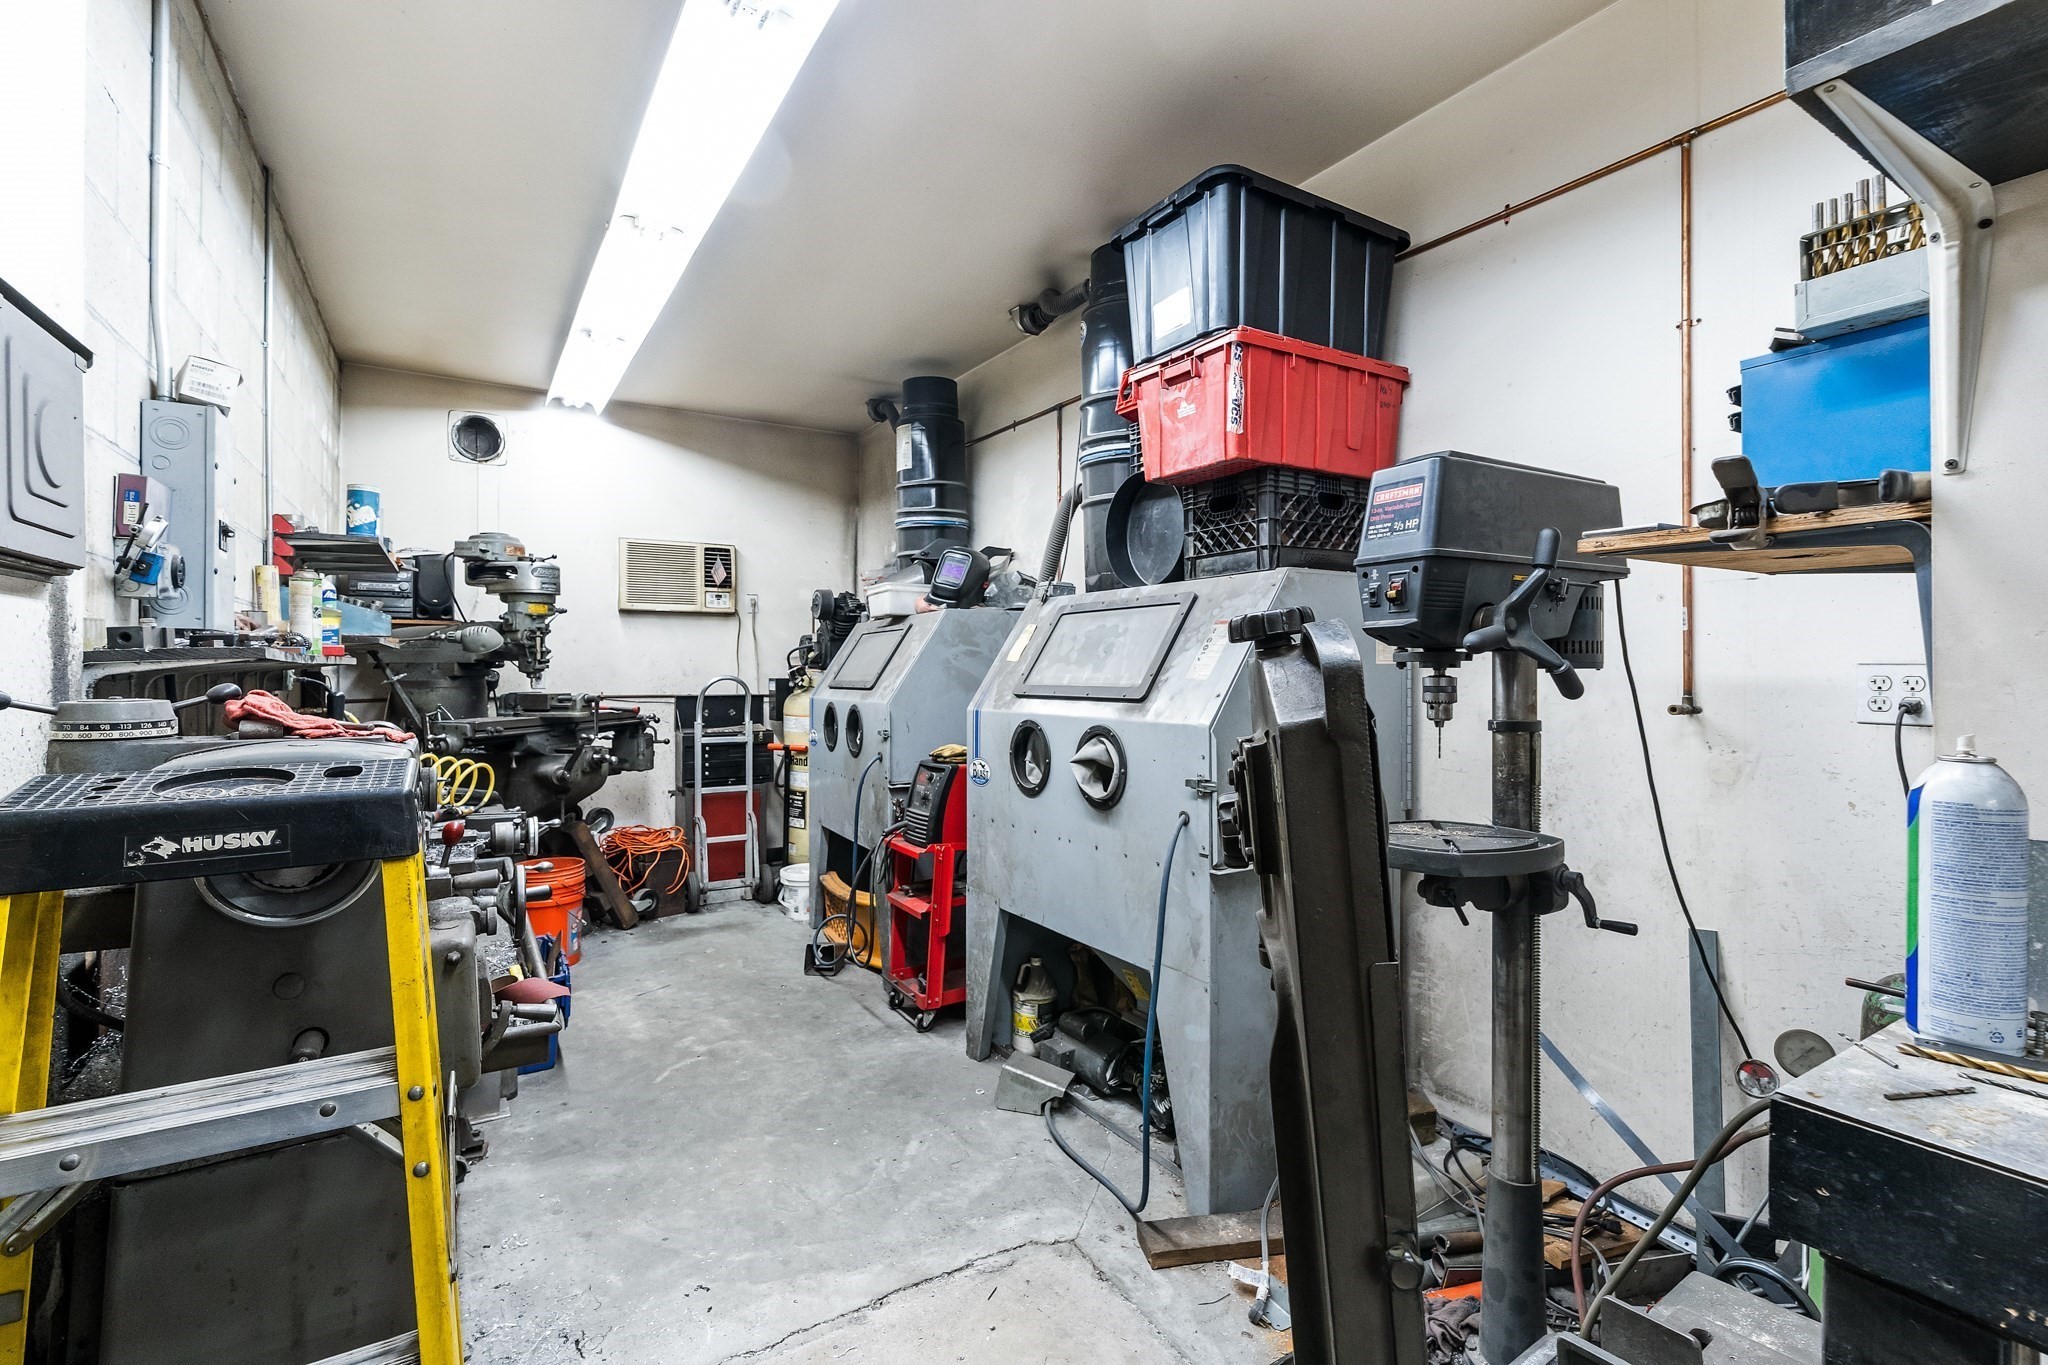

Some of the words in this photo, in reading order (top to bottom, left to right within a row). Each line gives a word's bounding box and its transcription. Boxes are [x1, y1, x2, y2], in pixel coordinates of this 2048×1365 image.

[1375, 486, 1422, 502] CRAFTSMAN
[1385, 503, 1404, 511] Variable
[1404, 500, 1421, 508] Speed
[1405, 518, 1419, 529] HP
[791, 755, 808, 767] Rand
[181, 830, 277, 853] HUSKY
